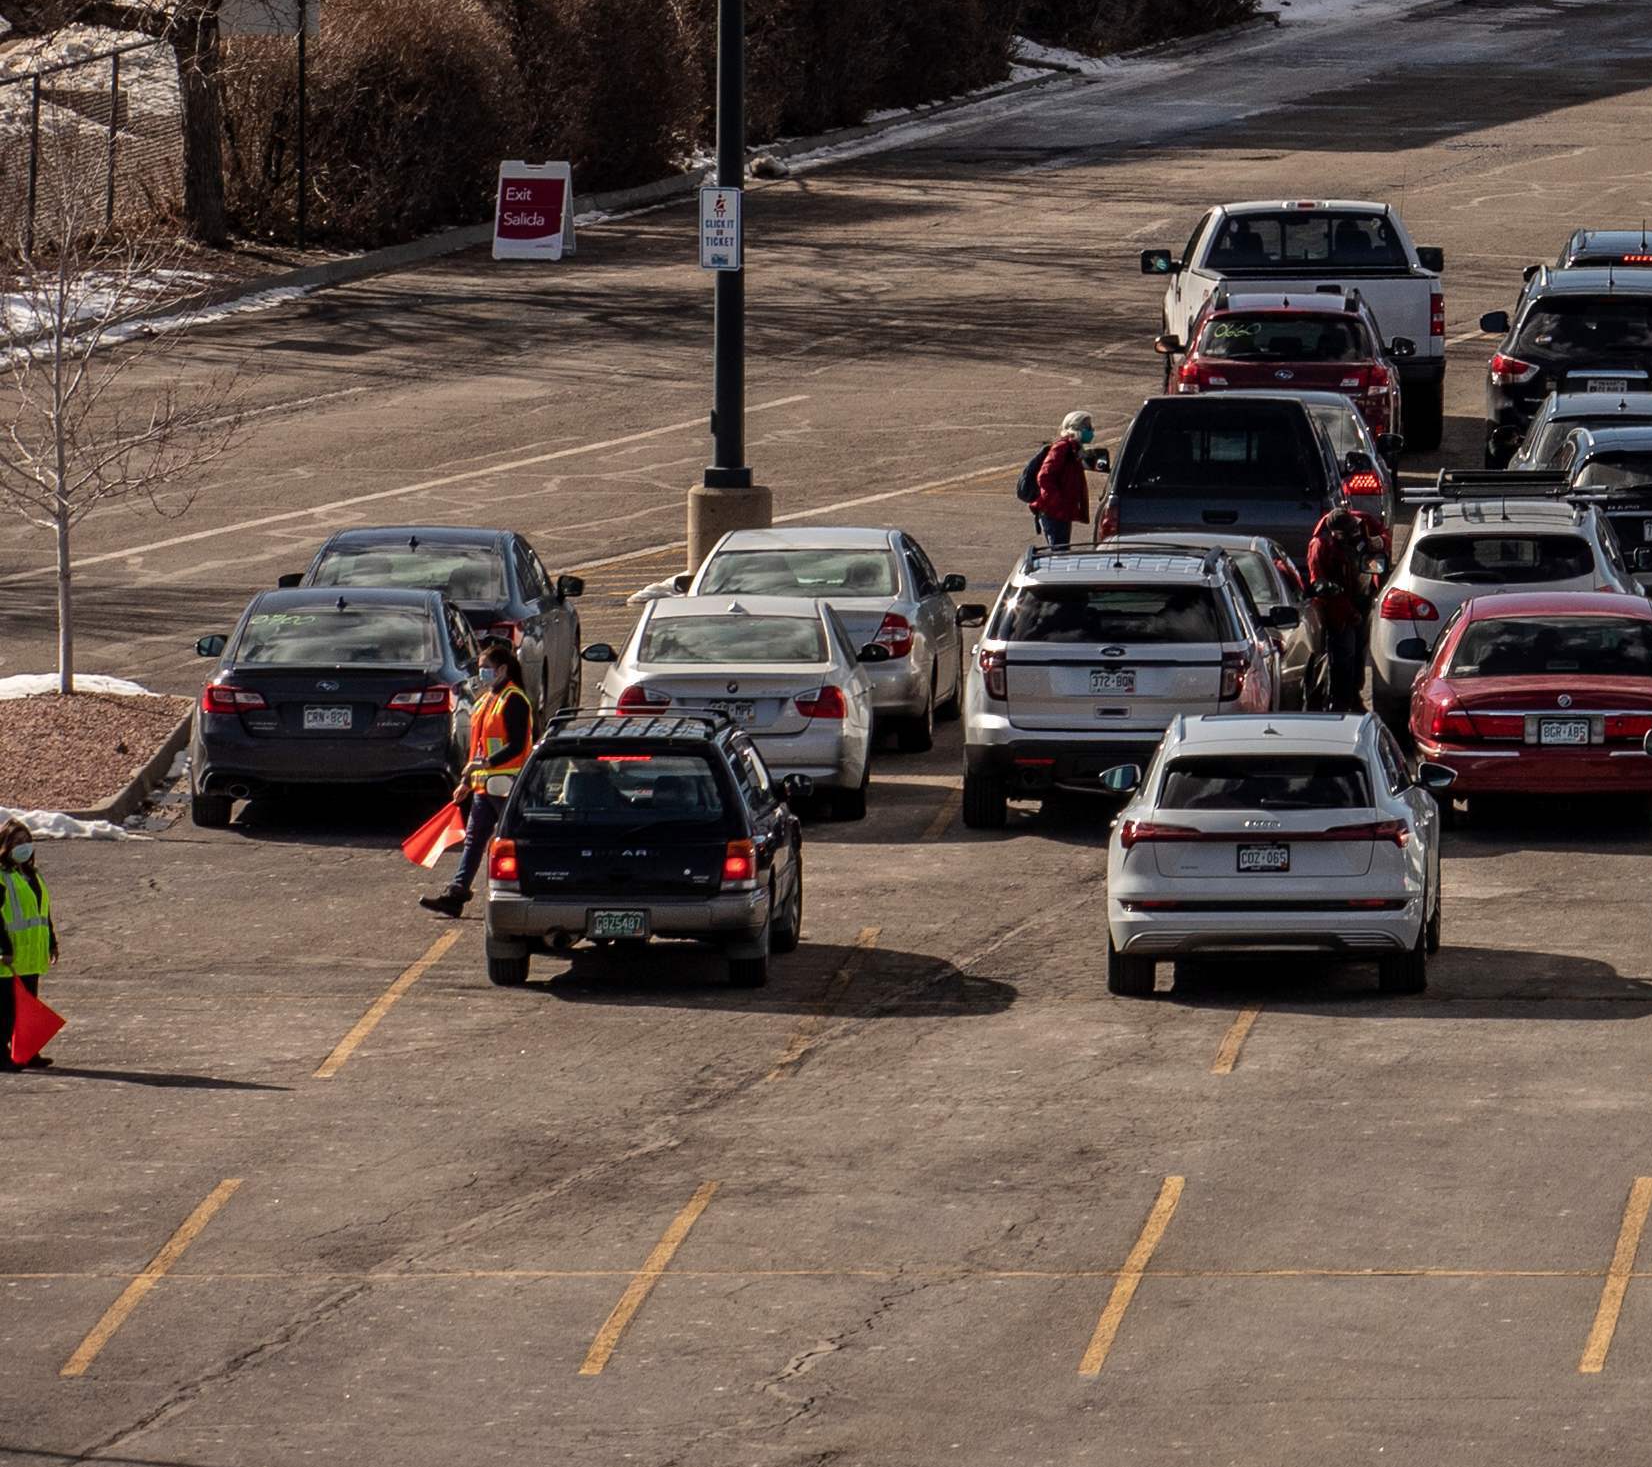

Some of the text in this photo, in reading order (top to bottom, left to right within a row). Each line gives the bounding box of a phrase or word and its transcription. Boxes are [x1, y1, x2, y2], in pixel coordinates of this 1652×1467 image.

[504, 187, 531, 202] Exit
[503, 211, 545, 227] Salida
[704, 219, 724, 229] CLICK
[704, 236, 734, 247] TICKET
